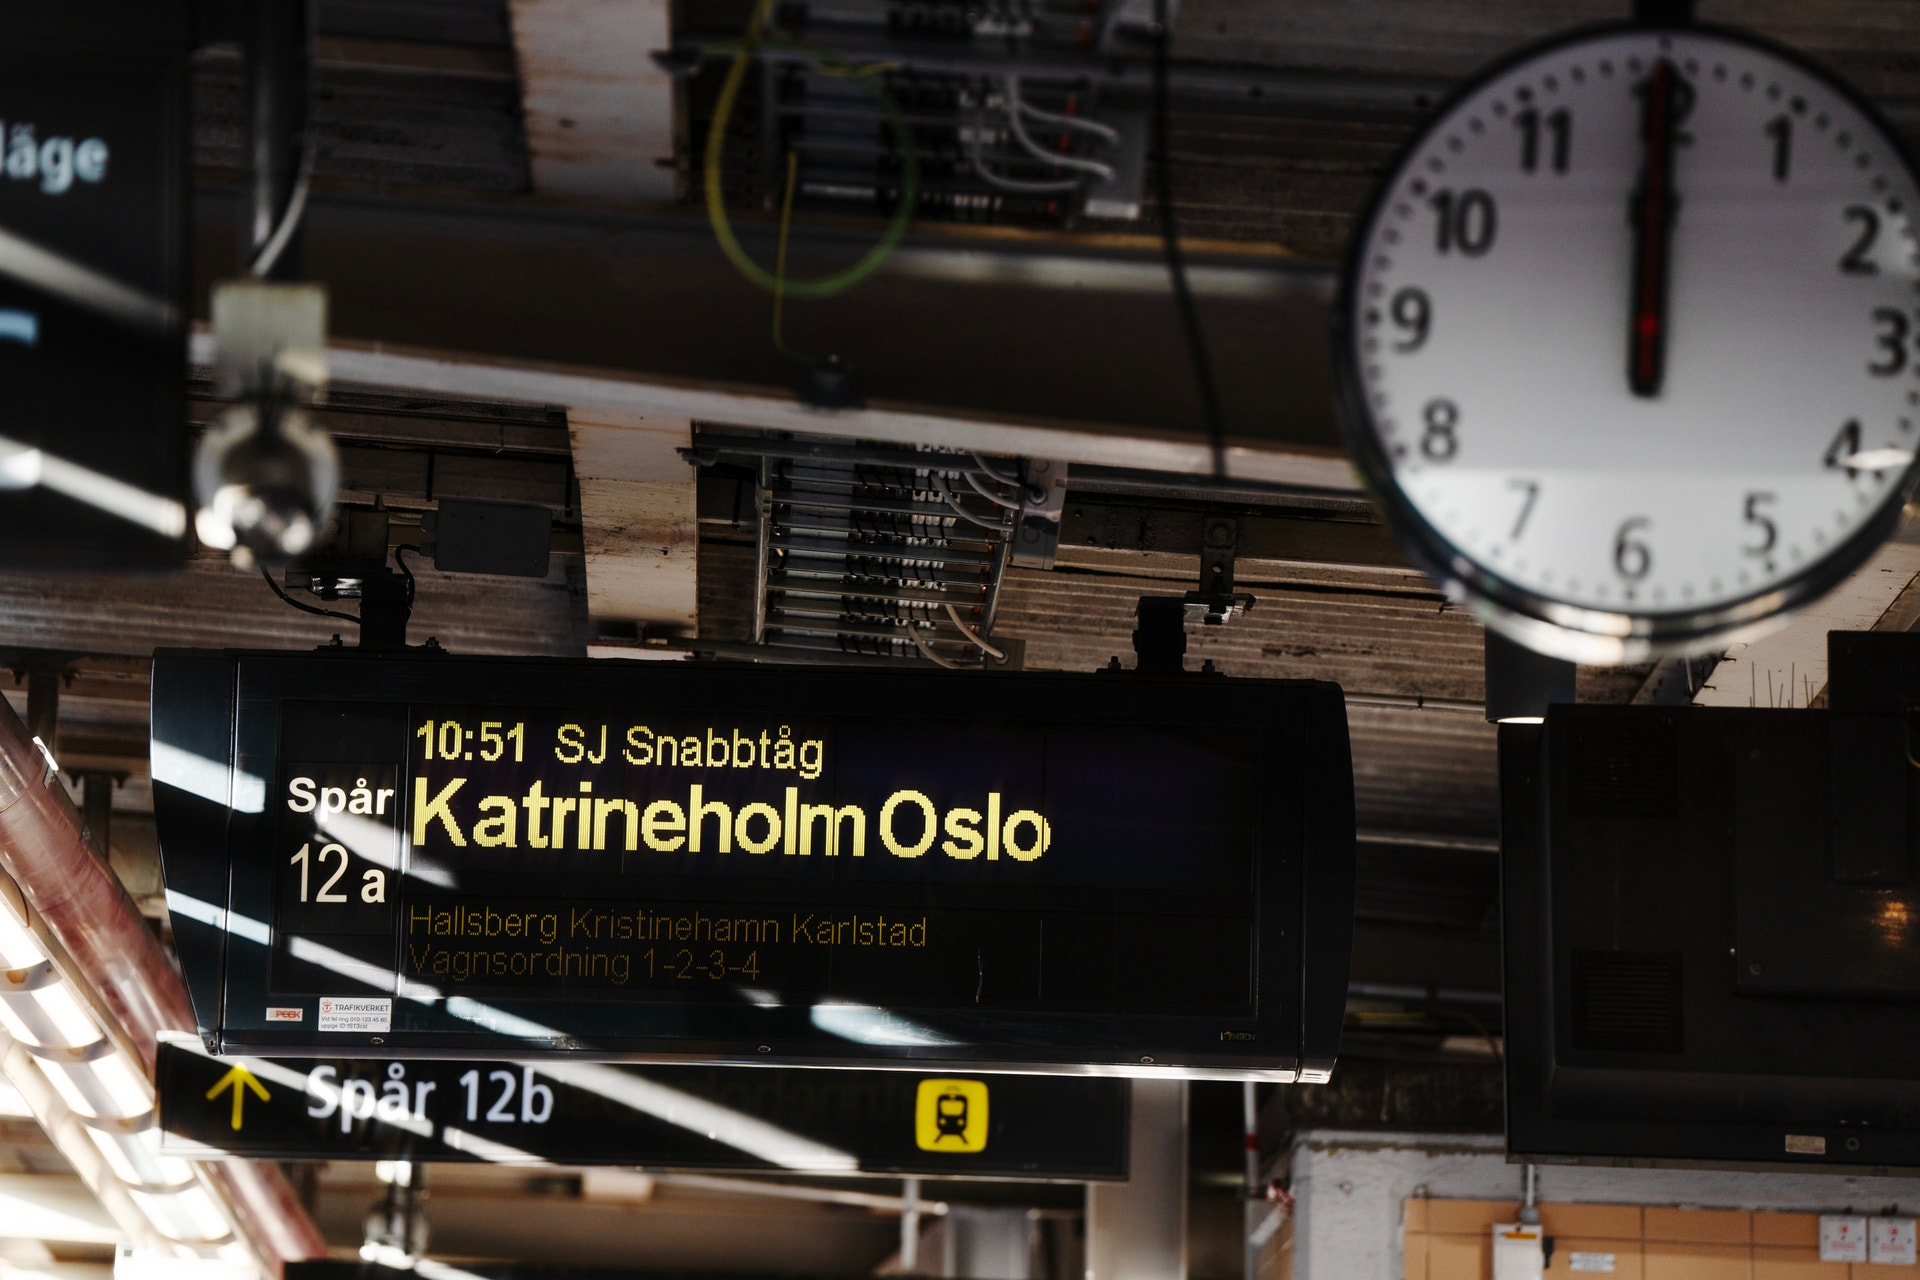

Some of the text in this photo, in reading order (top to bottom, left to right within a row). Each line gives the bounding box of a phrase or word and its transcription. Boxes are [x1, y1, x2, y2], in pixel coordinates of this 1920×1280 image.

[1511, 104, 1573, 176] 11
[1764, 113, 1794, 183] 1
[1427, 188, 1497, 258] 10
[1837, 205, 1882, 277] 2
[1390, 287, 1432, 354] 9
[1867, 307, 1911, 377] 3
[1420, 398, 1460, 464] 8
[1822, 417, 1862, 480] 4
[1507, 479, 1541, 543] 7
[1742, 491, 1778, 560] 5
[1614, 516, 1653, 584] 6
[416, 719, 824, 780] 10:51 SJ Snabbtåg
[286, 776, 395, 822] Spår
[413, 775, 1052, 863] Katrineholm Oslo
[289, 842, 387, 904] 12 a
[409, 904, 928, 948] Hallsberg Kristinehamn Karlstad
[408, 941, 762, 985] Vagnsordning 1-2-3-4
[275, 1010, 301, 1019] PEEK
[334, 1003, 390, 1012] TRAFIKVERKET
[306, 1062, 437, 1134] Spår
[458, 1066, 555, 1124] 12b
